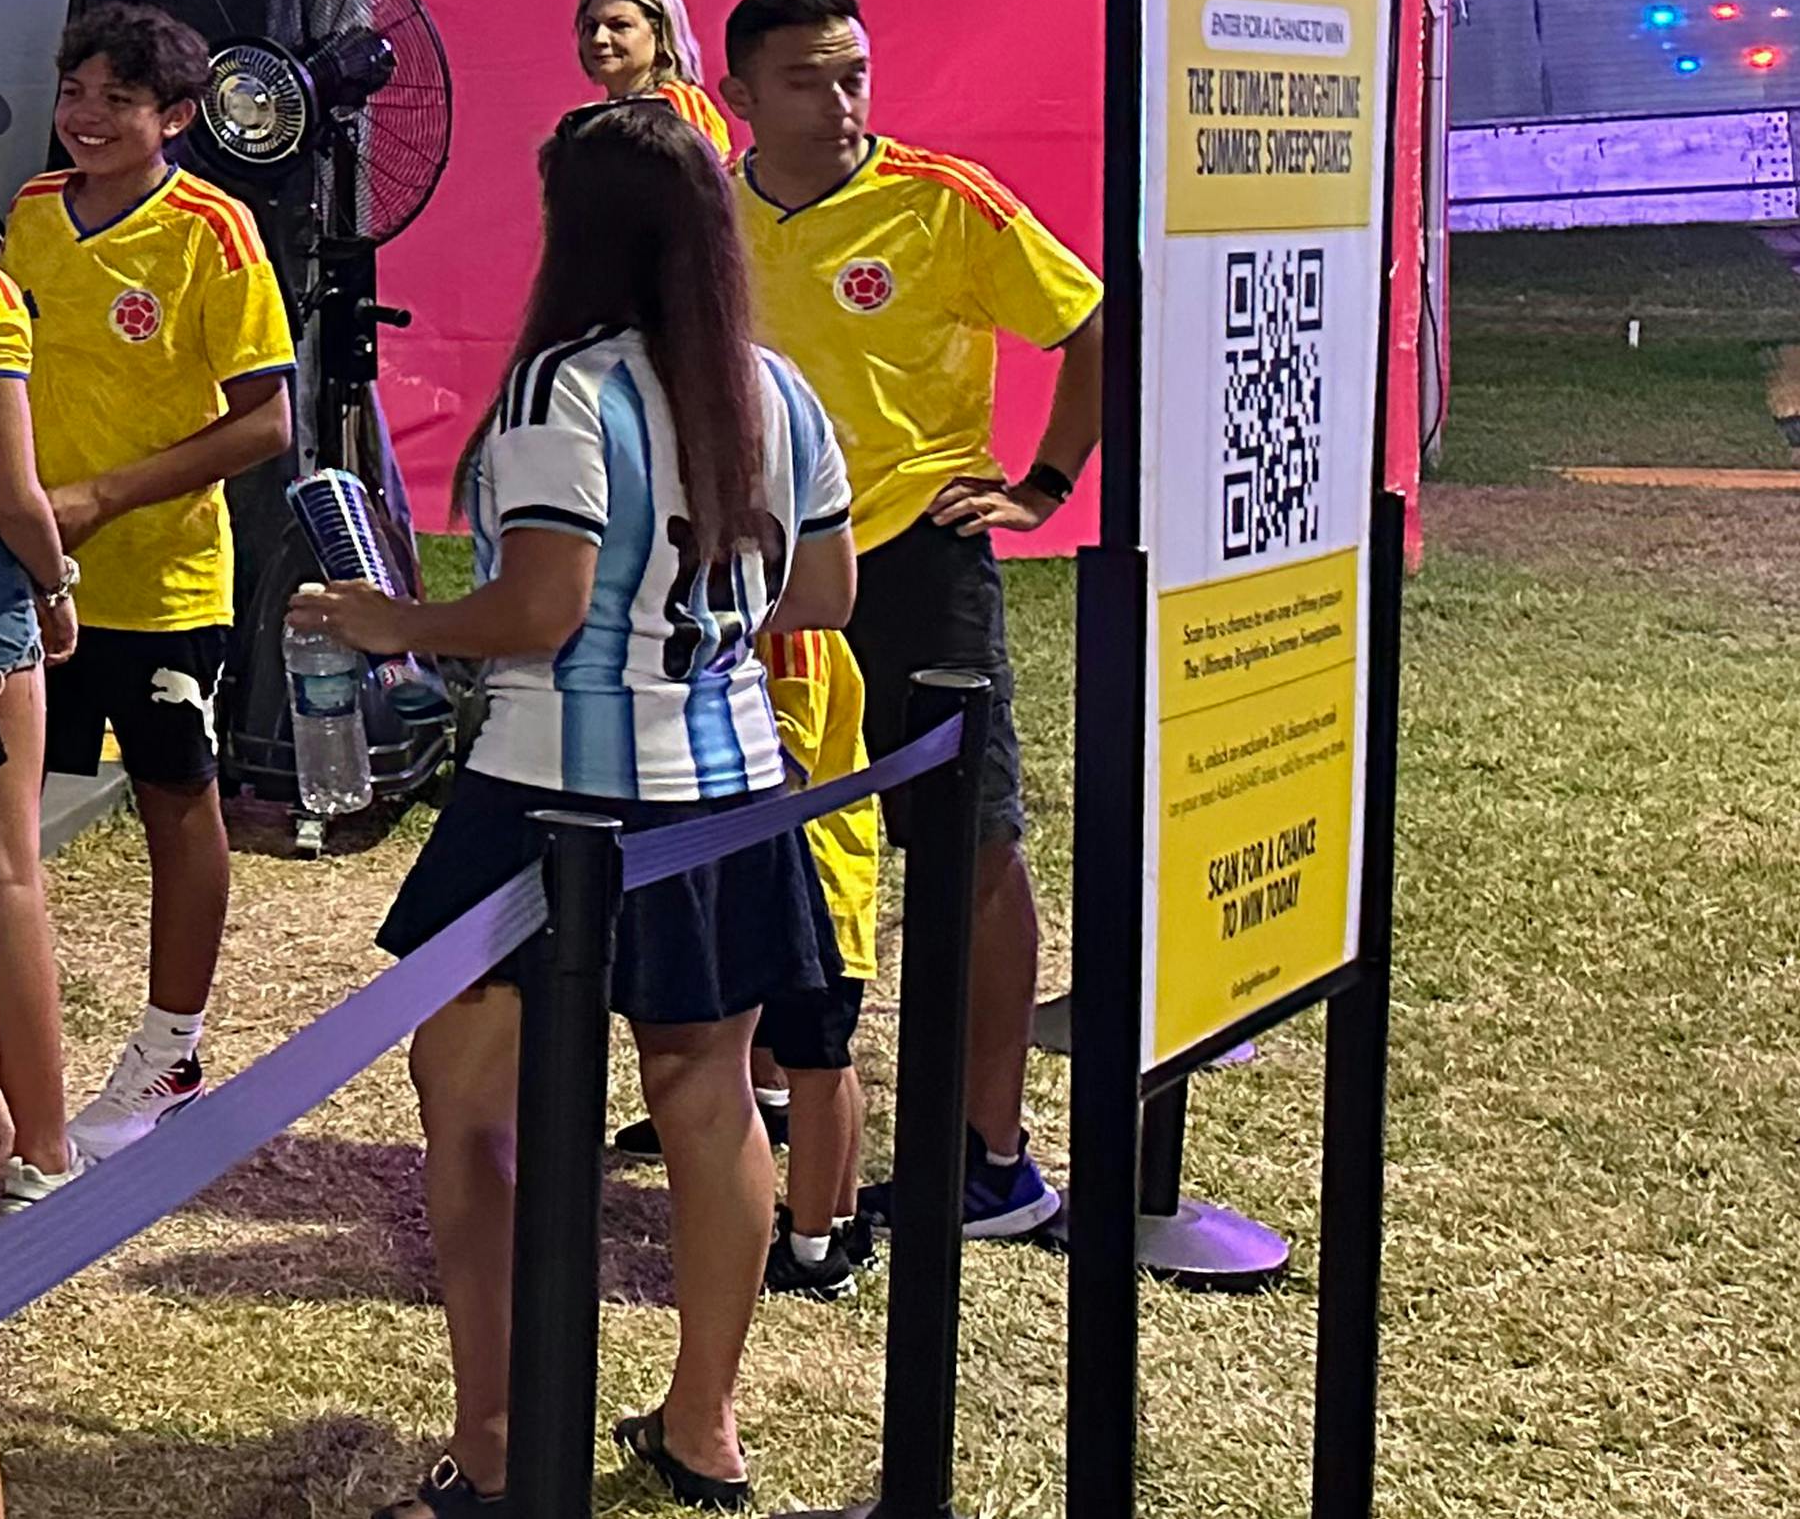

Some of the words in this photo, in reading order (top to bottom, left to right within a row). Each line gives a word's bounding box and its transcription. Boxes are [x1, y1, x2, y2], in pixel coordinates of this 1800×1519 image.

[1187, 67, 1215, 115] THE
[1219, 69, 1284, 117] ULTIMATE
[1288, 71, 1361, 119] BRIGHTLINE
[1196, 127, 1262, 175] SUMMER
[1265, 127, 1353, 175] SWEEPSTAKES
[1207, 850, 1240, 901] SCAN
[1241, 840, 1265, 887] FOR
[1265, 836, 1275, 875] A
[1276, 816, 1317, 870] CHANCE
[1222, 898, 1238, 941] TO
[1240, 887, 1264, 933] WIN
[1265, 869, 1302, 921] TODAY
